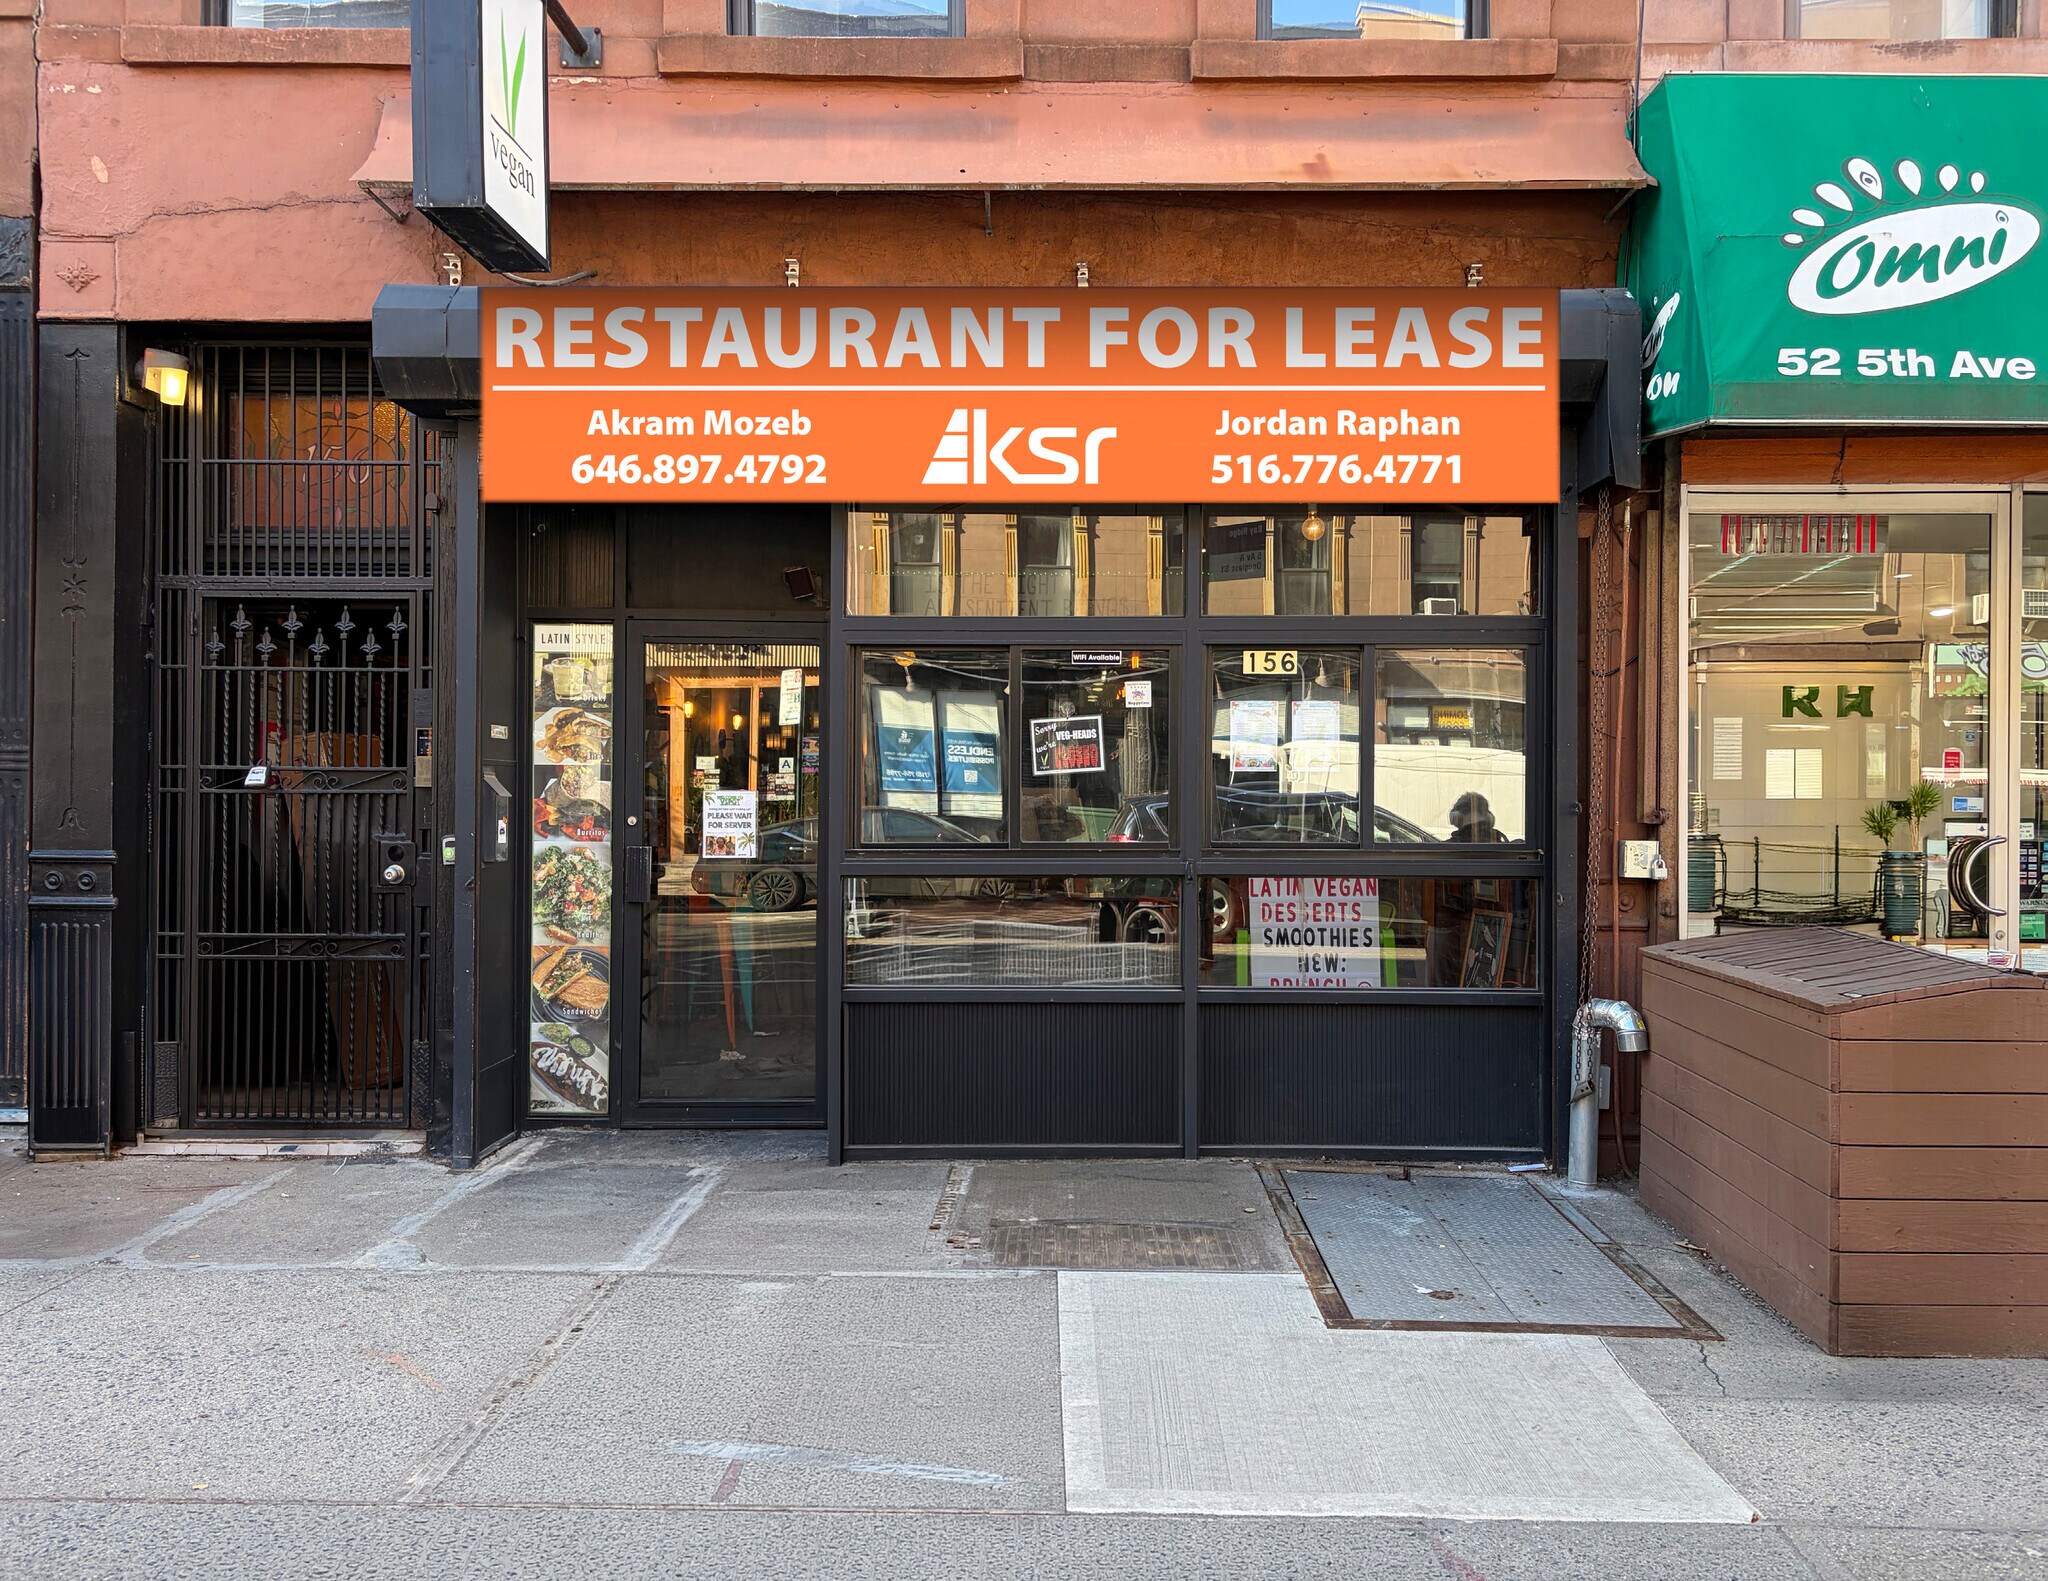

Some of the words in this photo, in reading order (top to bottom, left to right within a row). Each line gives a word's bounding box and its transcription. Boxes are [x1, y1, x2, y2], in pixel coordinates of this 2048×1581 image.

[490, 130, 536, 199] vegan
[496, 306, 1061, 369] RESTAURANT
[1088, 306, 1258, 369] FOR
[1285, 306, 1544, 369] LEASE
[1777, 347, 1842, 377] 52
[1856, 348, 1937, 378] 5th
[1949, 350, 2037, 380] Ave
[587, 409, 695, 436] Akram
[703, 409, 812, 436] Mozeb
[1215, 408, 1327, 436] Jordan
[1338, 408, 1461, 442] Raphan
[571, 454, 827, 485] 646.897.4792
[1211, 454, 1462, 485] 516.776.4771
[1003, 573, 1059, 596] IGHT
[541, 633, 570, 645] LATIN
[575, 633, 606, 645] STYLE
[1249, 652, 1295, 673] 156
[1055, 728, 1098, 741] VEG-HEADS
[707, 812, 733, 820] PLEASE
[734, 812, 753, 820] WAIT
[707, 821, 723, 829] FOR
[724, 821, 752, 829] SERVER
[576, 828, 605, 838] Burritos
[1249, 877, 1301, 898] LATIN
[1313, 877, 1378, 898] VEGAN
[1261, 902, 1362, 923] DESSERTS
[1263, 927, 1373, 948] SMOOTHIES
[562, 1007, 603, 1016] Sandwiches
